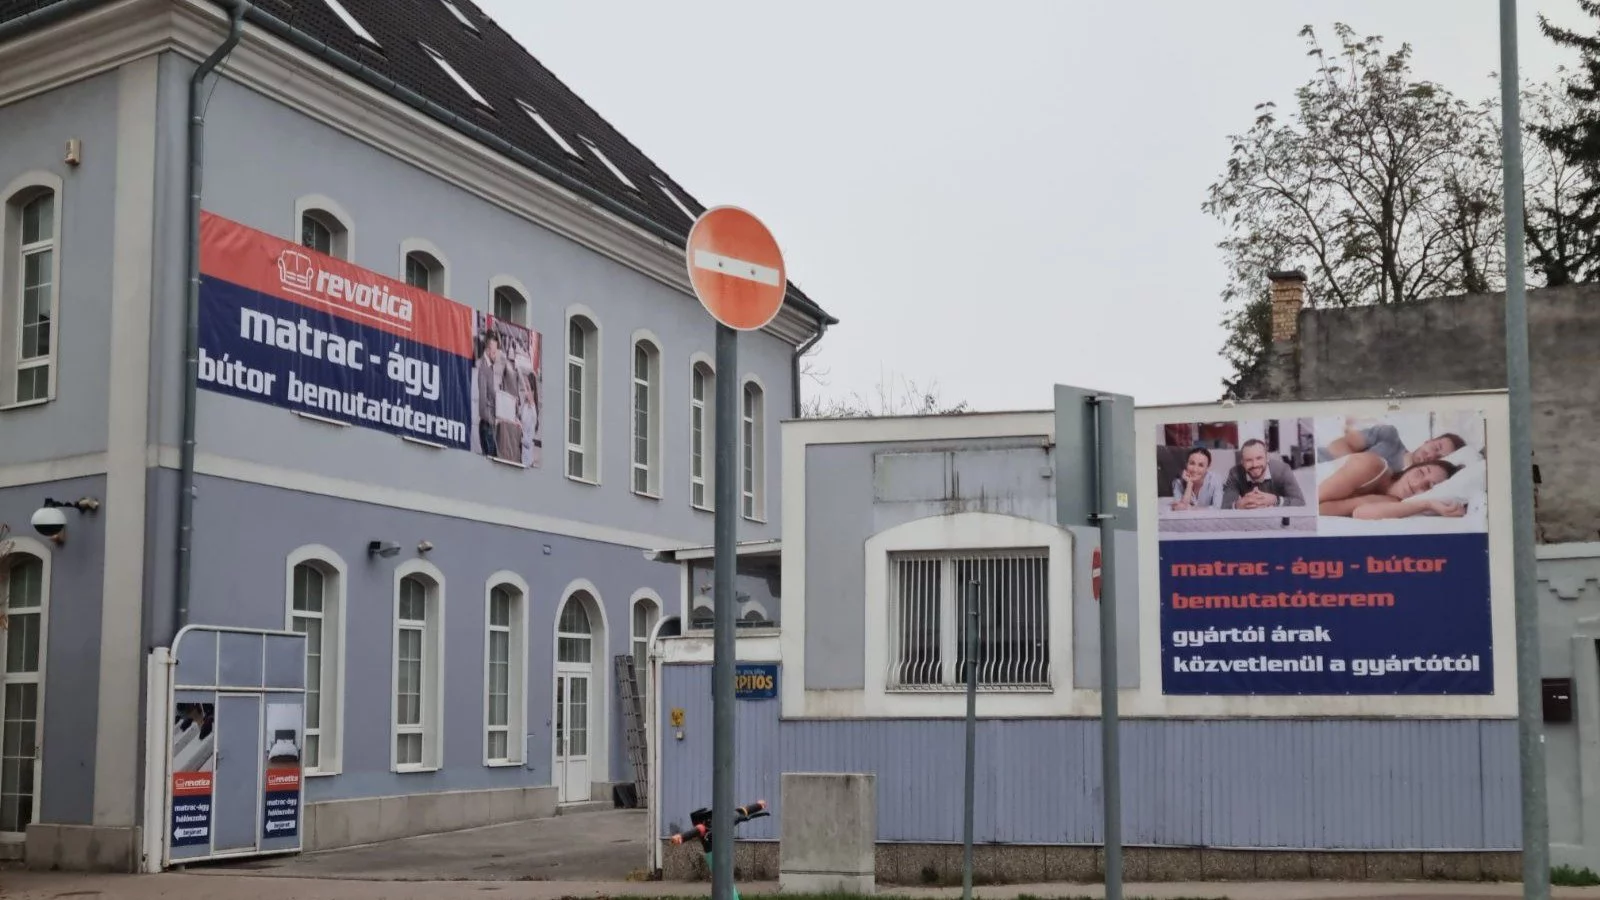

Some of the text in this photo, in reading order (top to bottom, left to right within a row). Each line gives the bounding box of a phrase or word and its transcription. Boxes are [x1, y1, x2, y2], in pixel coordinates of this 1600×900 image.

[316, 268, 413, 322] revotica
[240, 306, 364, 370] matrac
[387, 342, 440, 400] ágy
[198, 348, 466, 443] bútor bemutatóterem
[1171, 561, 1268, 577] matrac
[1291, 558, 1344, 579] ágy
[1366, 556, 1446, 573] bútor
[1172, 590, 1395, 609] bemutatóterem
[1172, 625, 1331, 647] gyártói árak
[1173, 654, 1480, 676] közvetlenül a gyártótól
